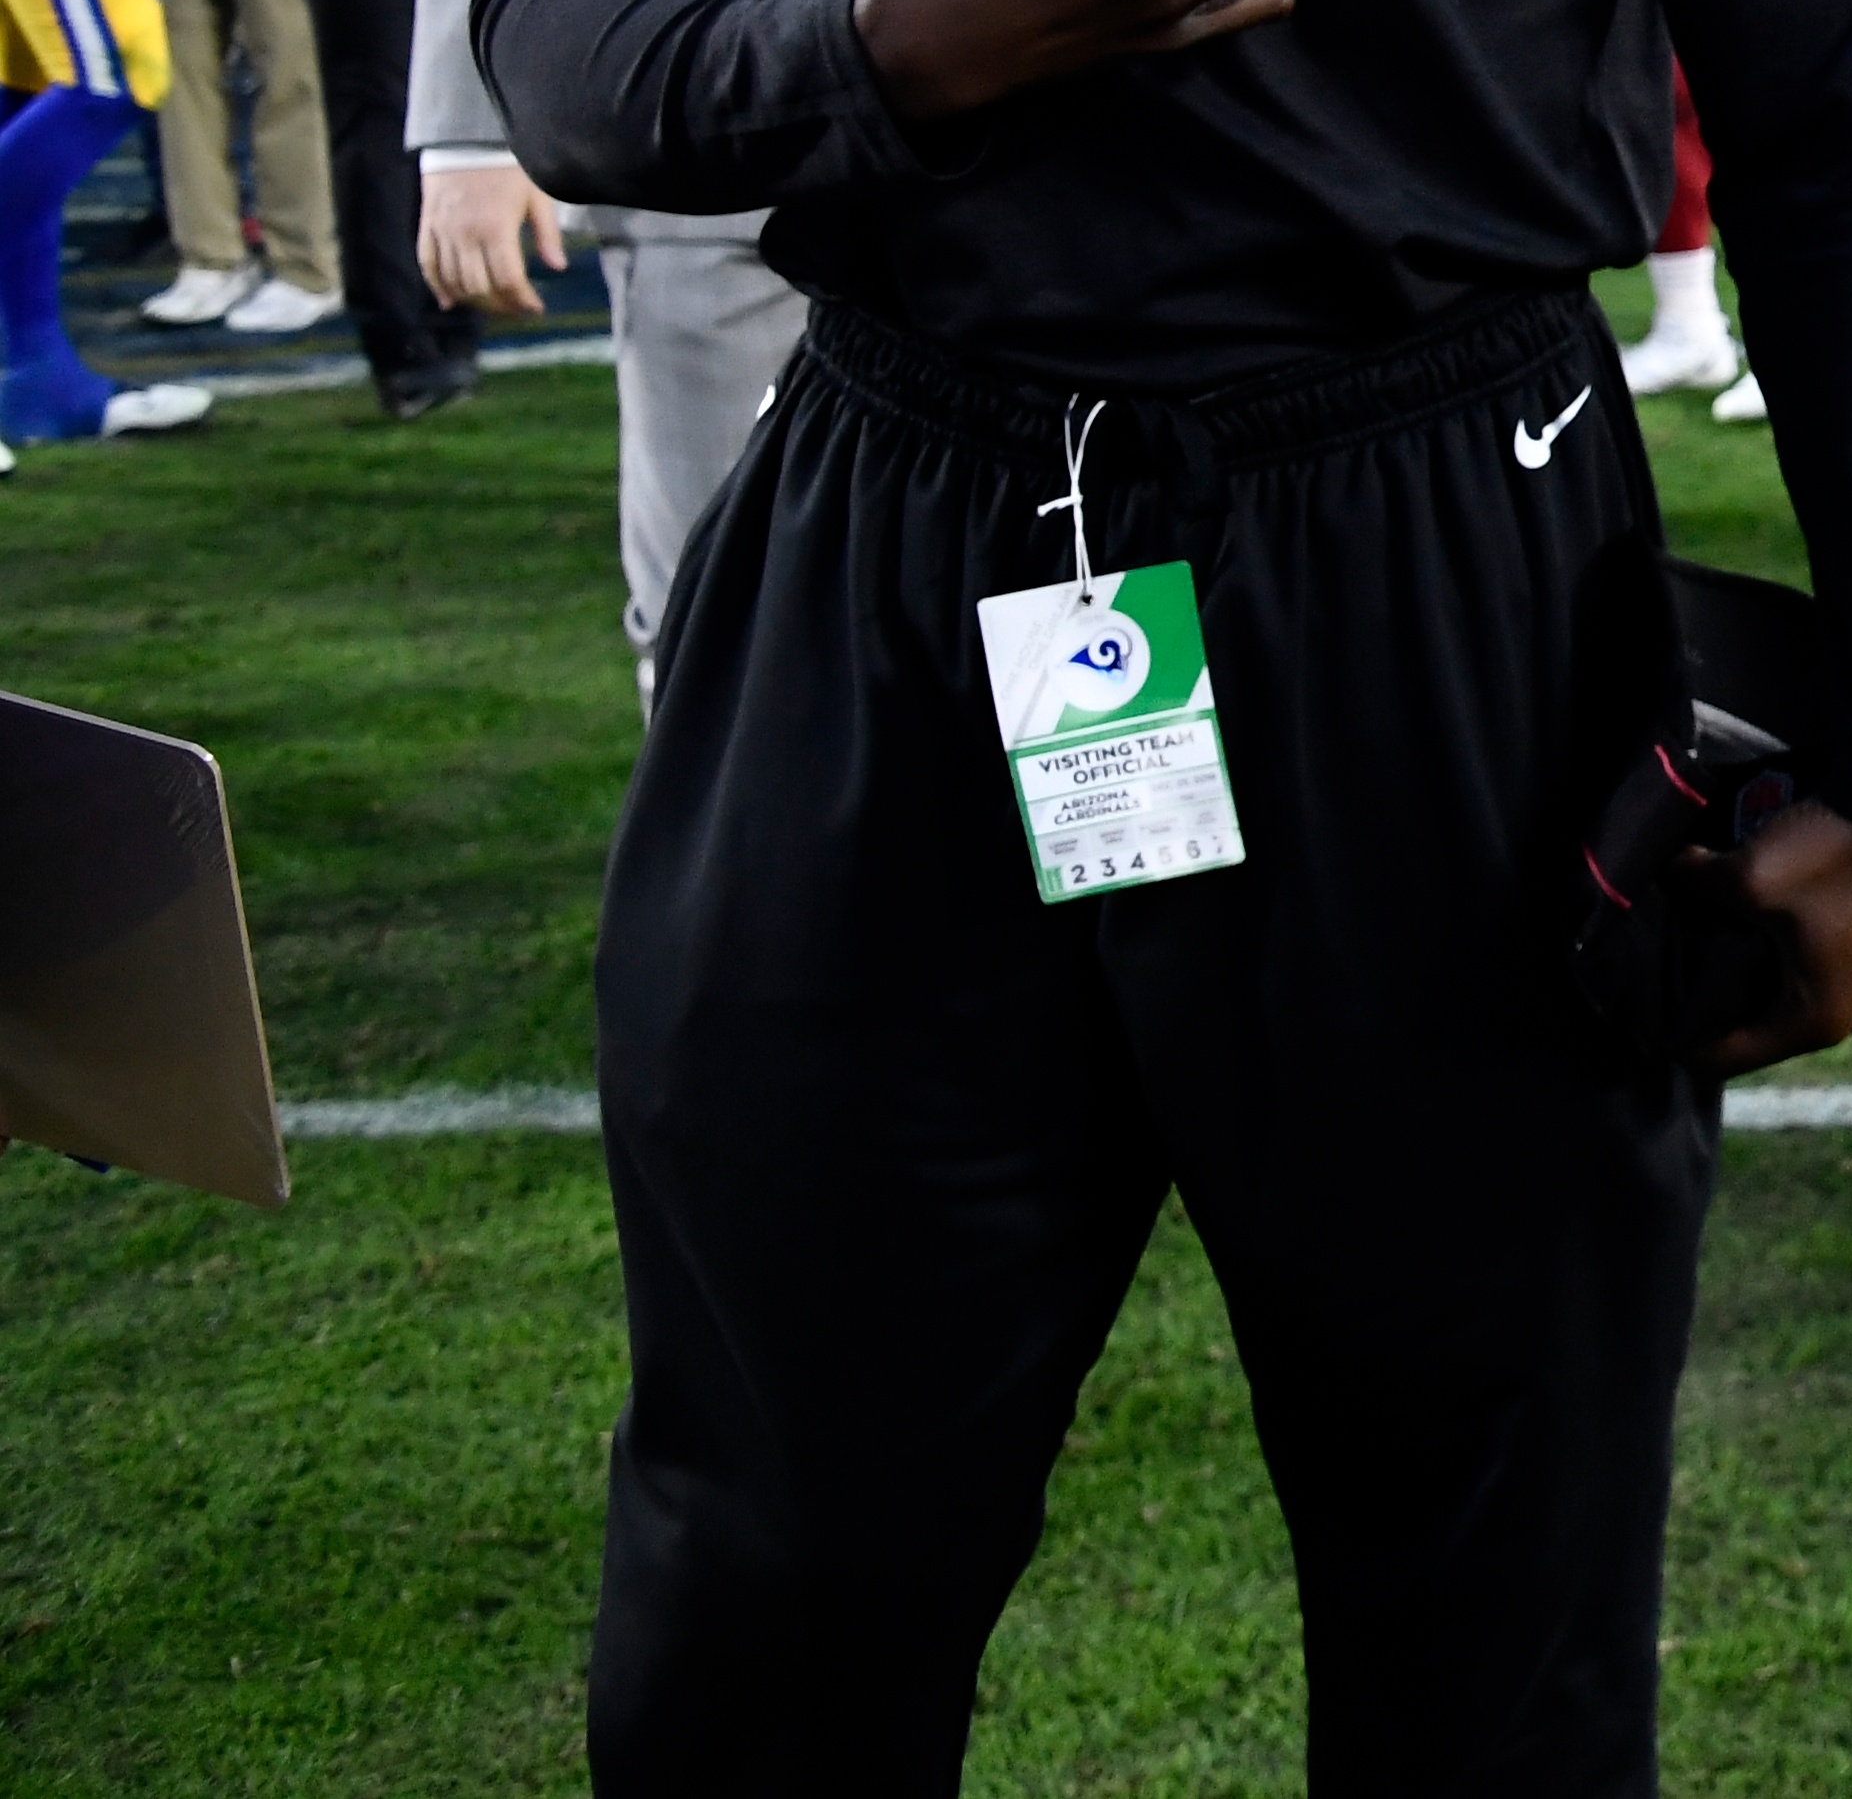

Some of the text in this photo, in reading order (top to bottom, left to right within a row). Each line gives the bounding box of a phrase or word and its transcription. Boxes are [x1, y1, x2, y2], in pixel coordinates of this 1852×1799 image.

[1038, 729, 1195, 774] VISITING TEAM
[1073, 753, 1171, 786] OFFICIAL
[1054, 799, 1142, 826] CARDINALS
[1061, 789, 1130, 812] ARIZONA
[1070, 864, 1088, 884] 2
[1101, 857, 1117, 877] 3
[1130, 852, 1146, 870] 4
